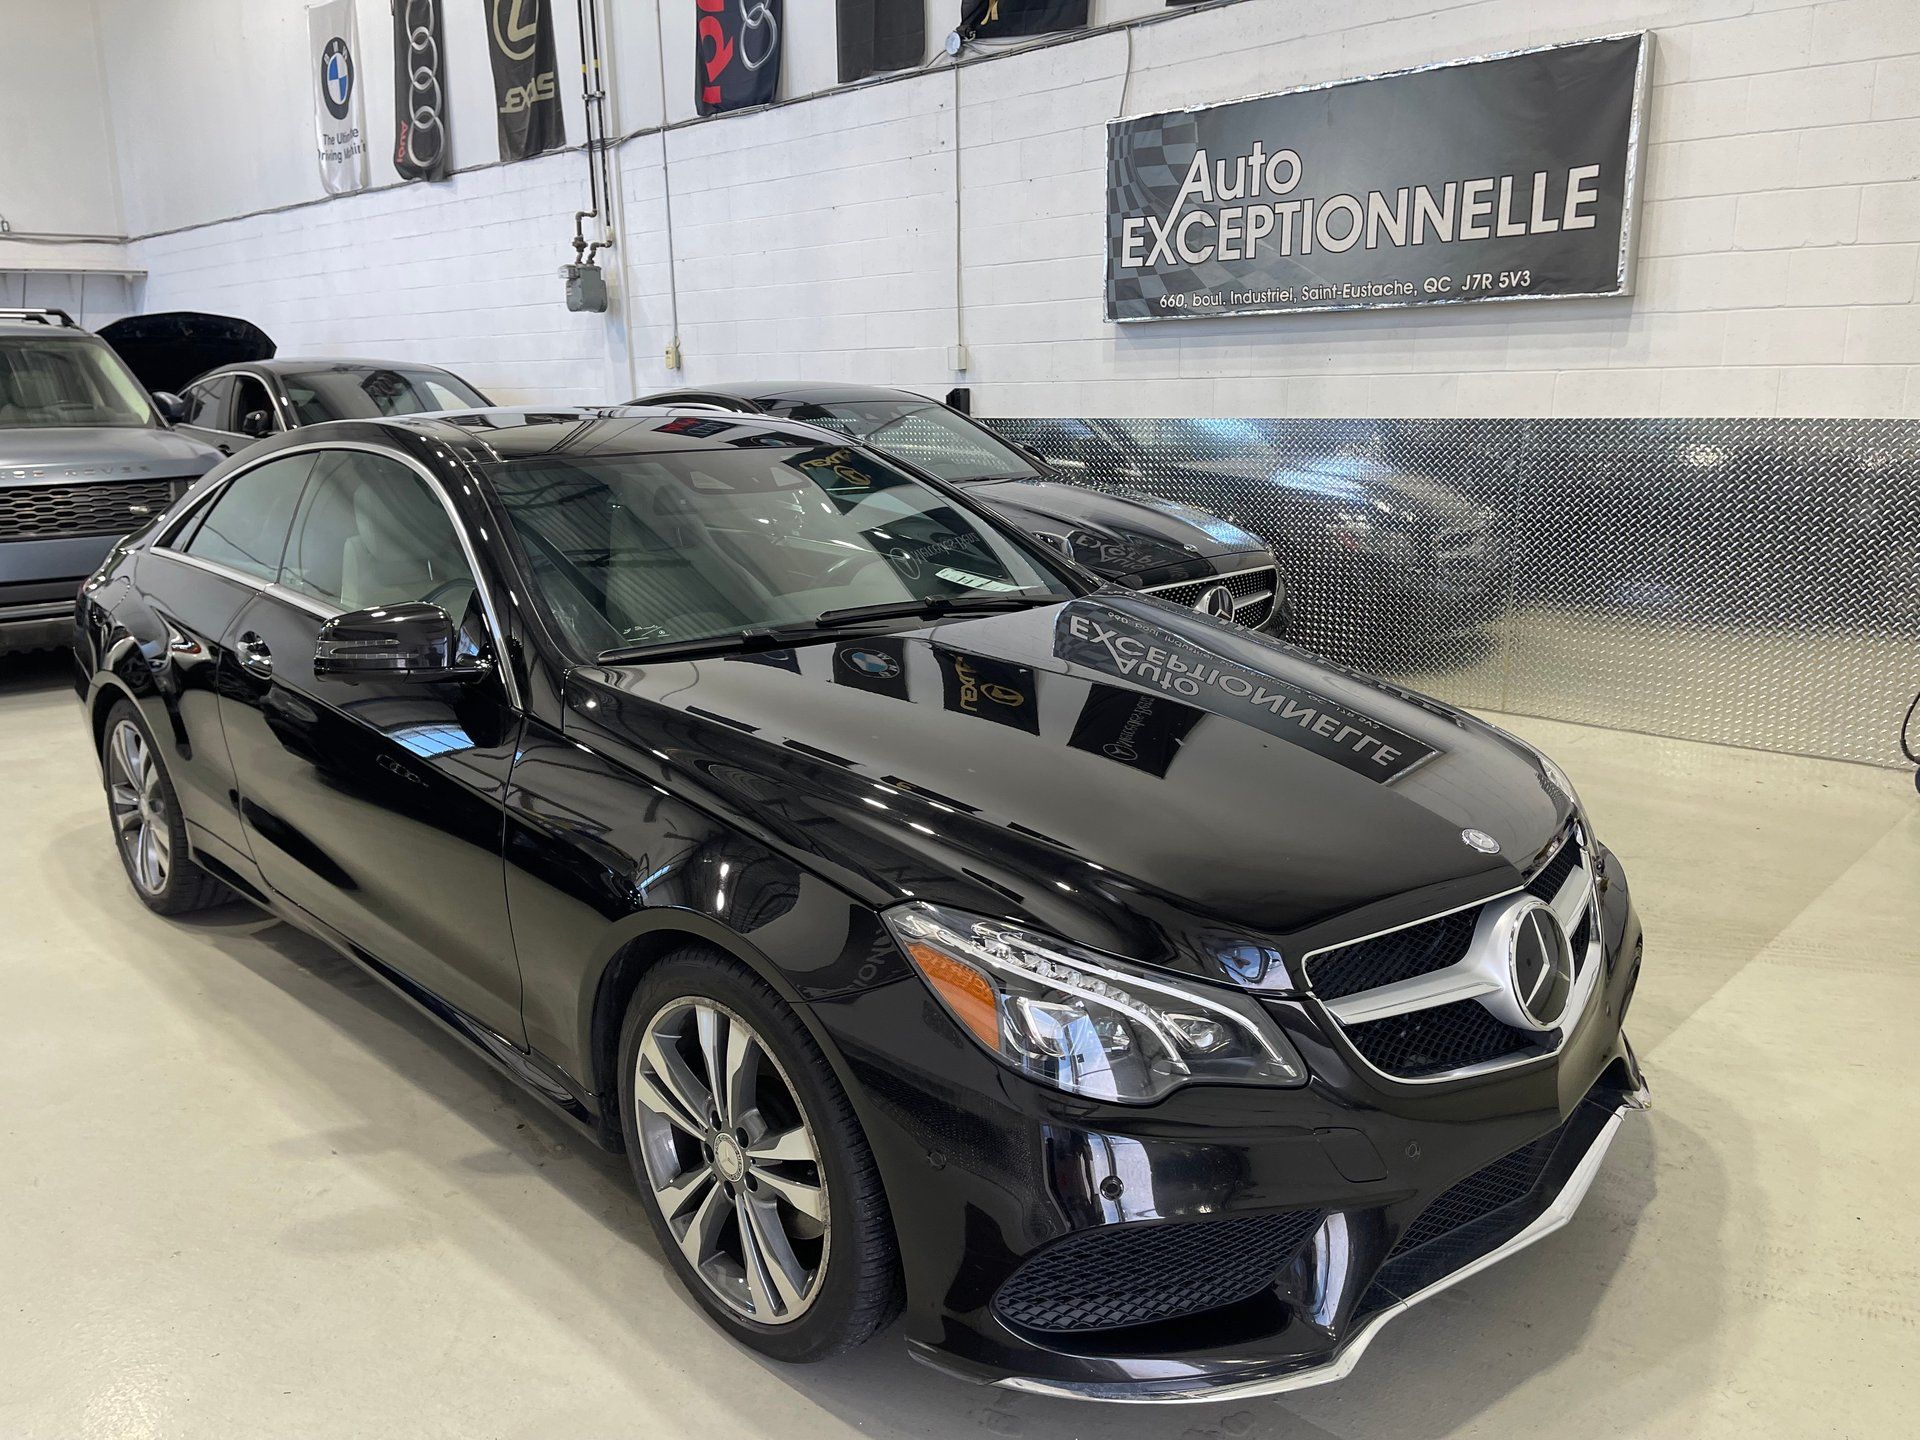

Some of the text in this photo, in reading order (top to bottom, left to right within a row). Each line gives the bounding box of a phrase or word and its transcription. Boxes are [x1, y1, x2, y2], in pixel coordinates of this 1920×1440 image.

[323, 133, 335, 146] The
[1176, 140, 1303, 203] Auto
[1121, 163, 1600, 268] EXCEPTIONNELLE
[1158, 270, 1531, 309] 660, boul. Industriel, Saint-Eustache, QC J7R 5V3
